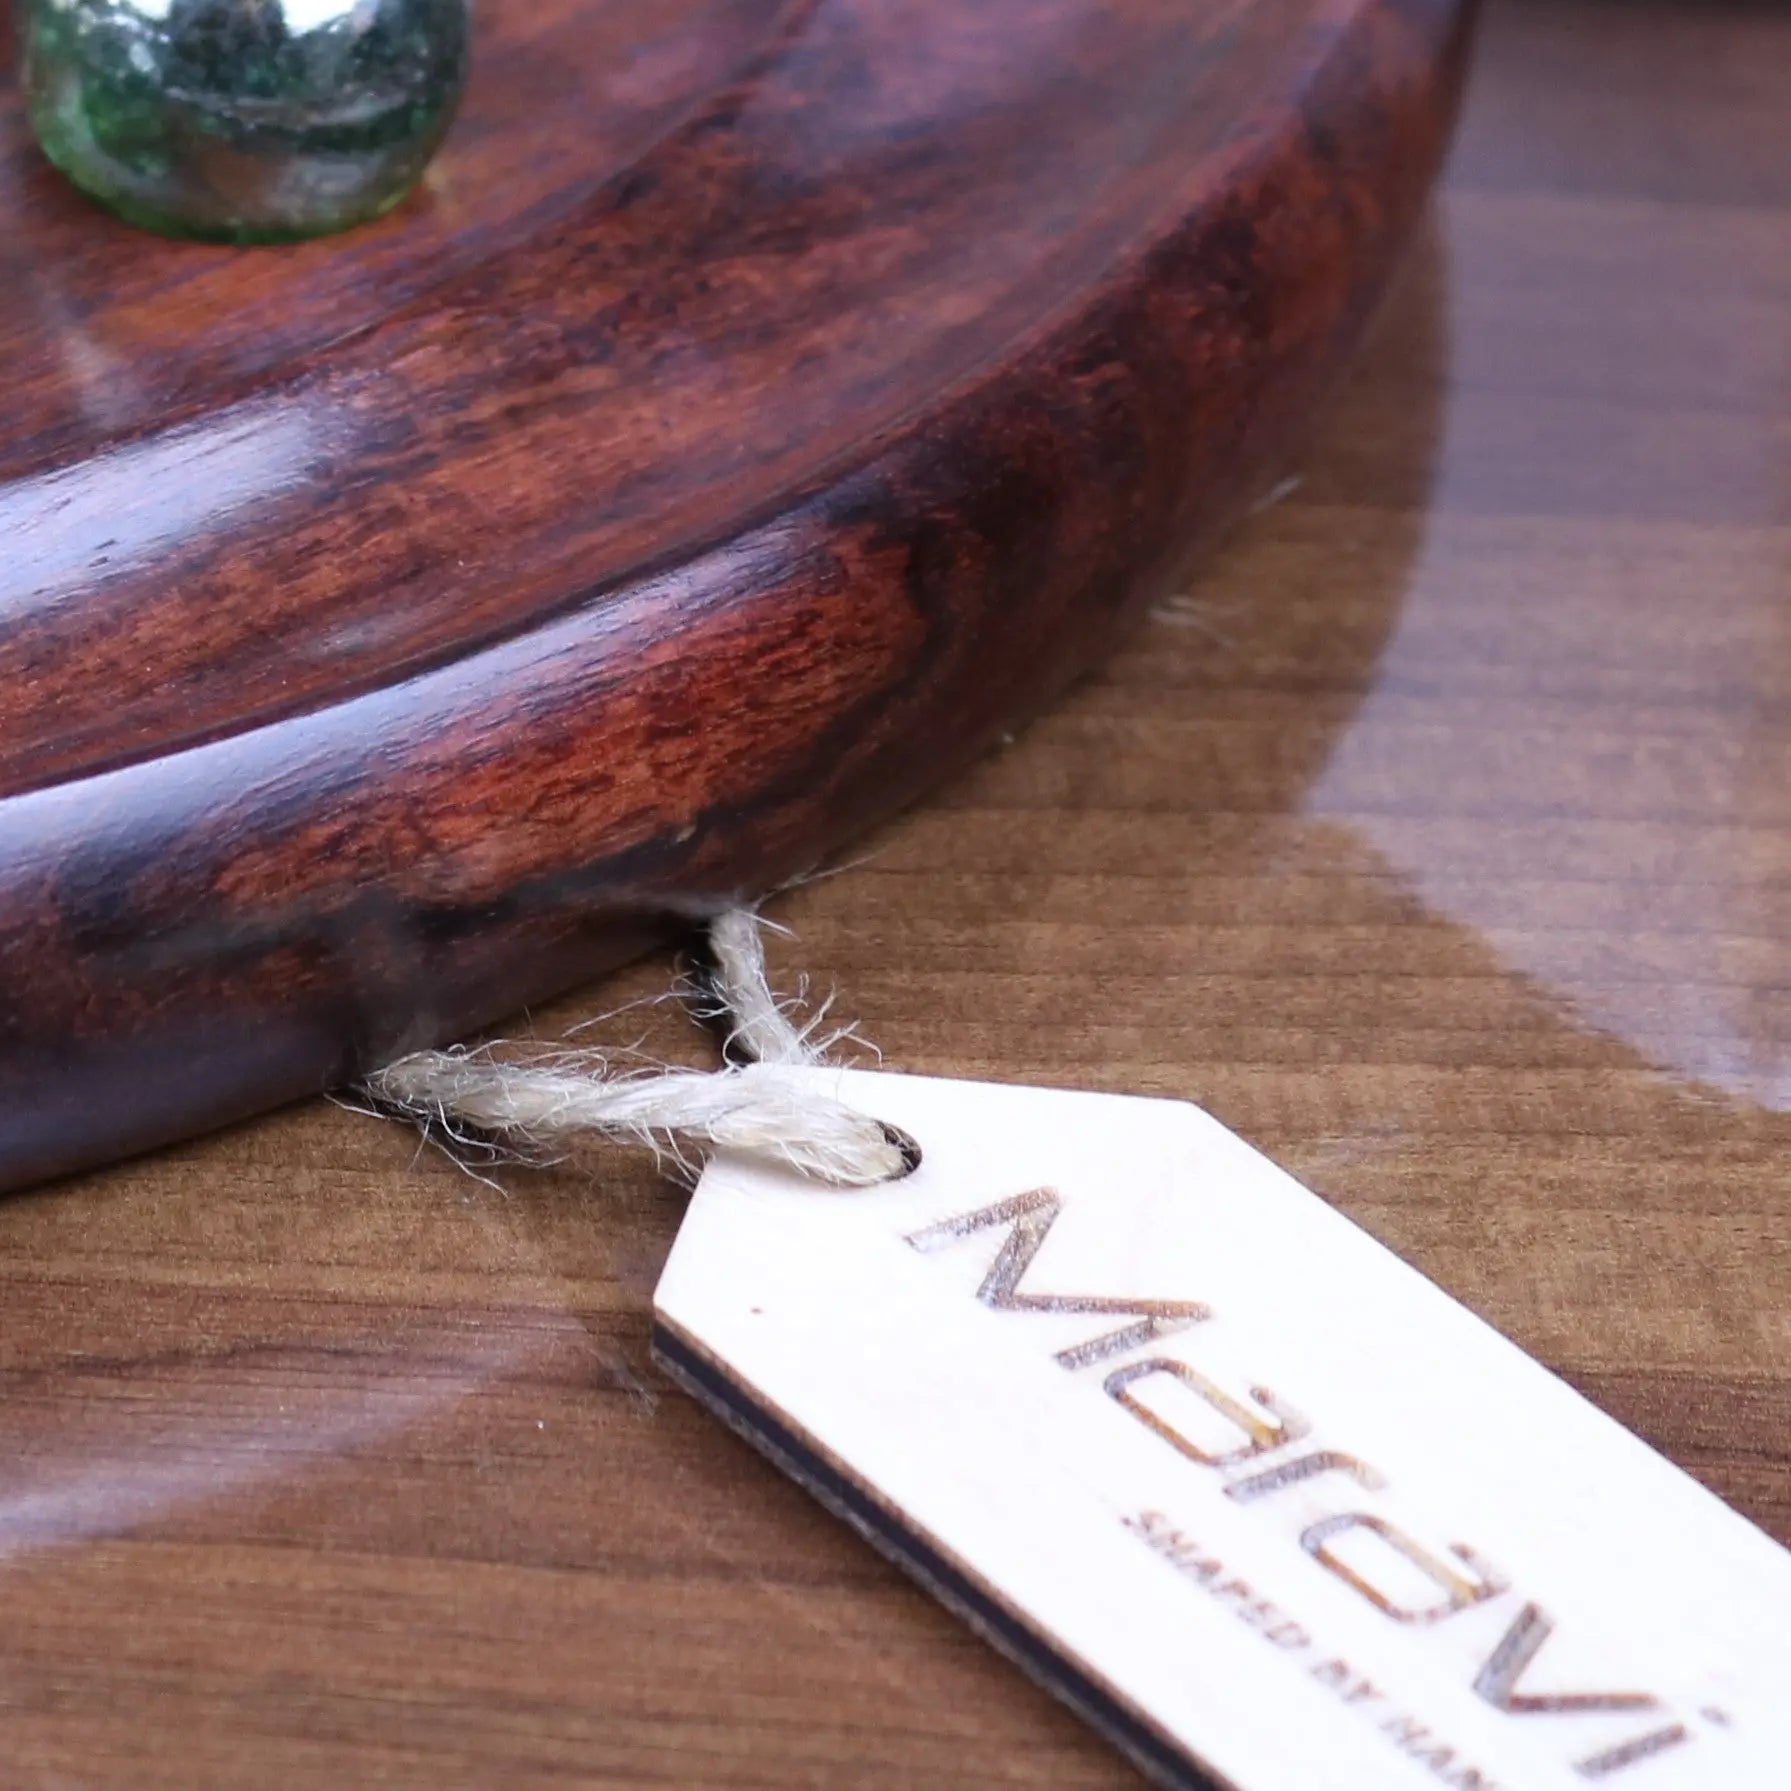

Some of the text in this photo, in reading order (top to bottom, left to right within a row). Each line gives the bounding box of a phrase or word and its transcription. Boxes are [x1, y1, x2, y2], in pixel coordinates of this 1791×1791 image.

[904, 1186, 1731, 1779] Maravi
[1121, 1511, 1311, 1649] SHAPED
[1310, 1659, 1386, 1702] BY
